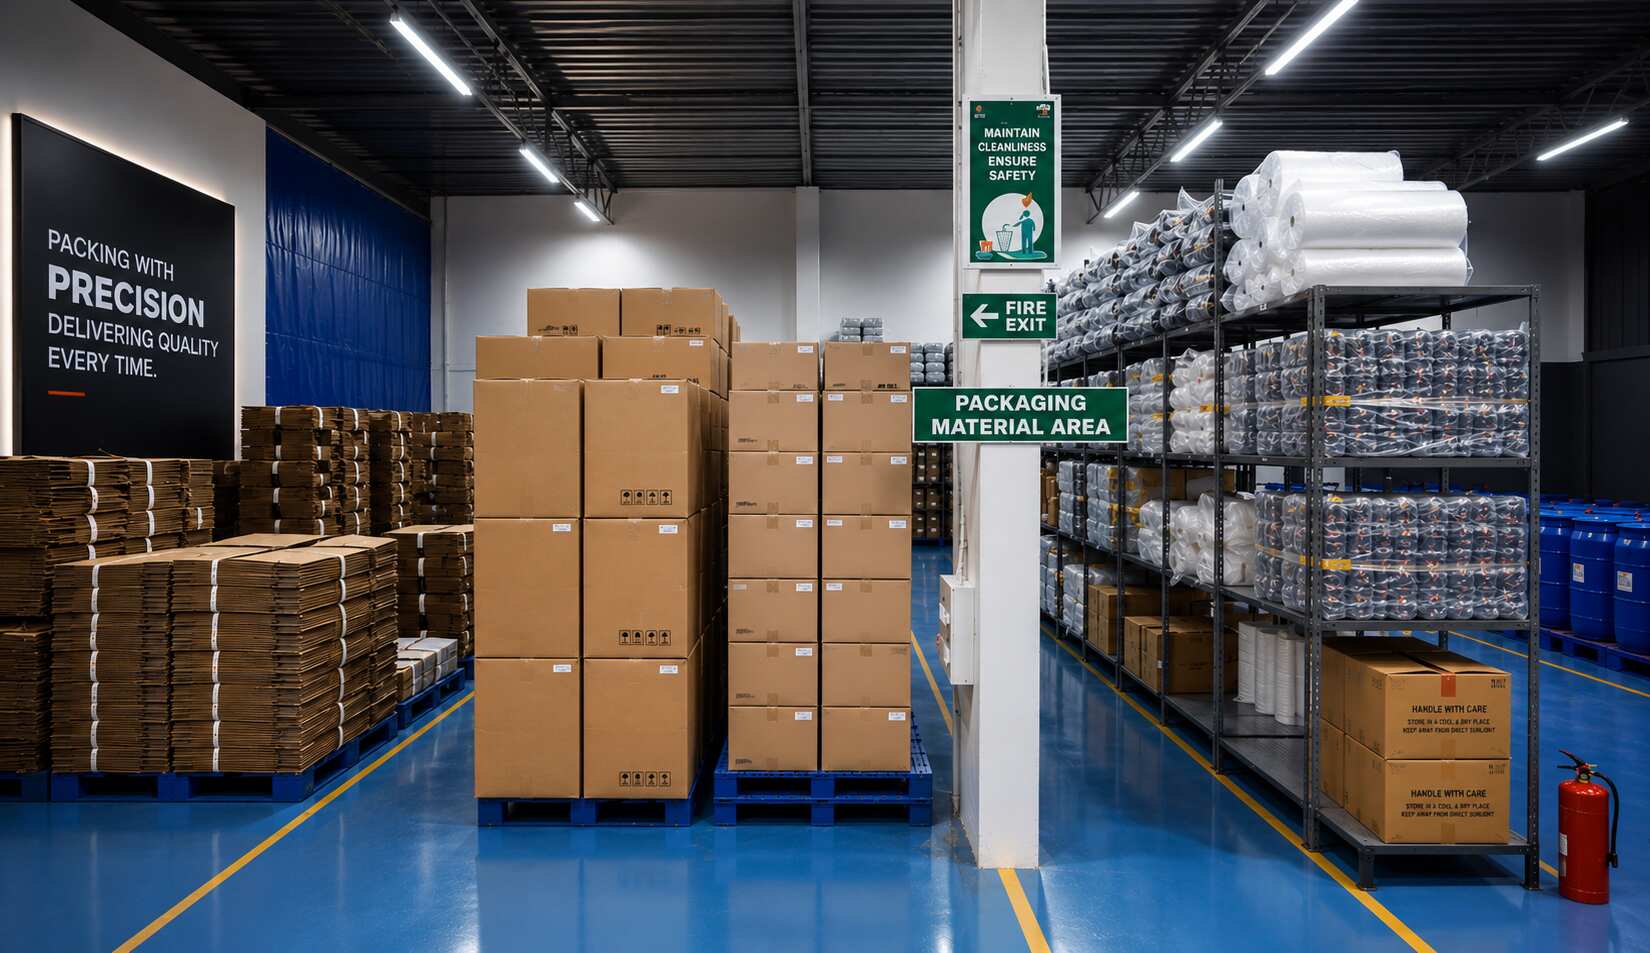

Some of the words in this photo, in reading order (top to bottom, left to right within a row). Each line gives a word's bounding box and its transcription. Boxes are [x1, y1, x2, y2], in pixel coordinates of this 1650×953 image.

[984, 127, 1040, 138] MAINTAIN
[978, 142, 1047, 152] CLEANLINESS
[988, 156, 1037, 166] ENSURE
[989, 170, 1036, 181] SAFETY
[48, 229, 130, 270] PACKING
[135, 254, 174, 281] WITH
[48, 263, 204, 328] PRECISION
[1005, 301, 1047, 315] FIRE
[1005, 317, 1047, 332] EXIT
[48, 312, 154, 349] DELIVERING
[158, 332, 219, 358] QUALITY
[48, 346, 110, 373] EVERY
[114, 355, 157, 378] TIME.
[955, 394, 1087, 412] PACKAGING
[931, 418, 1045, 435] MATERIAL
[1050, 418, 1111, 435] AREA
[1412, 705, 1442, 713] HANDLE
[1444, 705, 1464, 713] WITH
[1466, 705, 1488, 713] CARE
[1411, 790, 1441, 798] HANDLE
[1444, 790, 1464, 798] WITH
[1466, 790, 1487, 798] CARE
